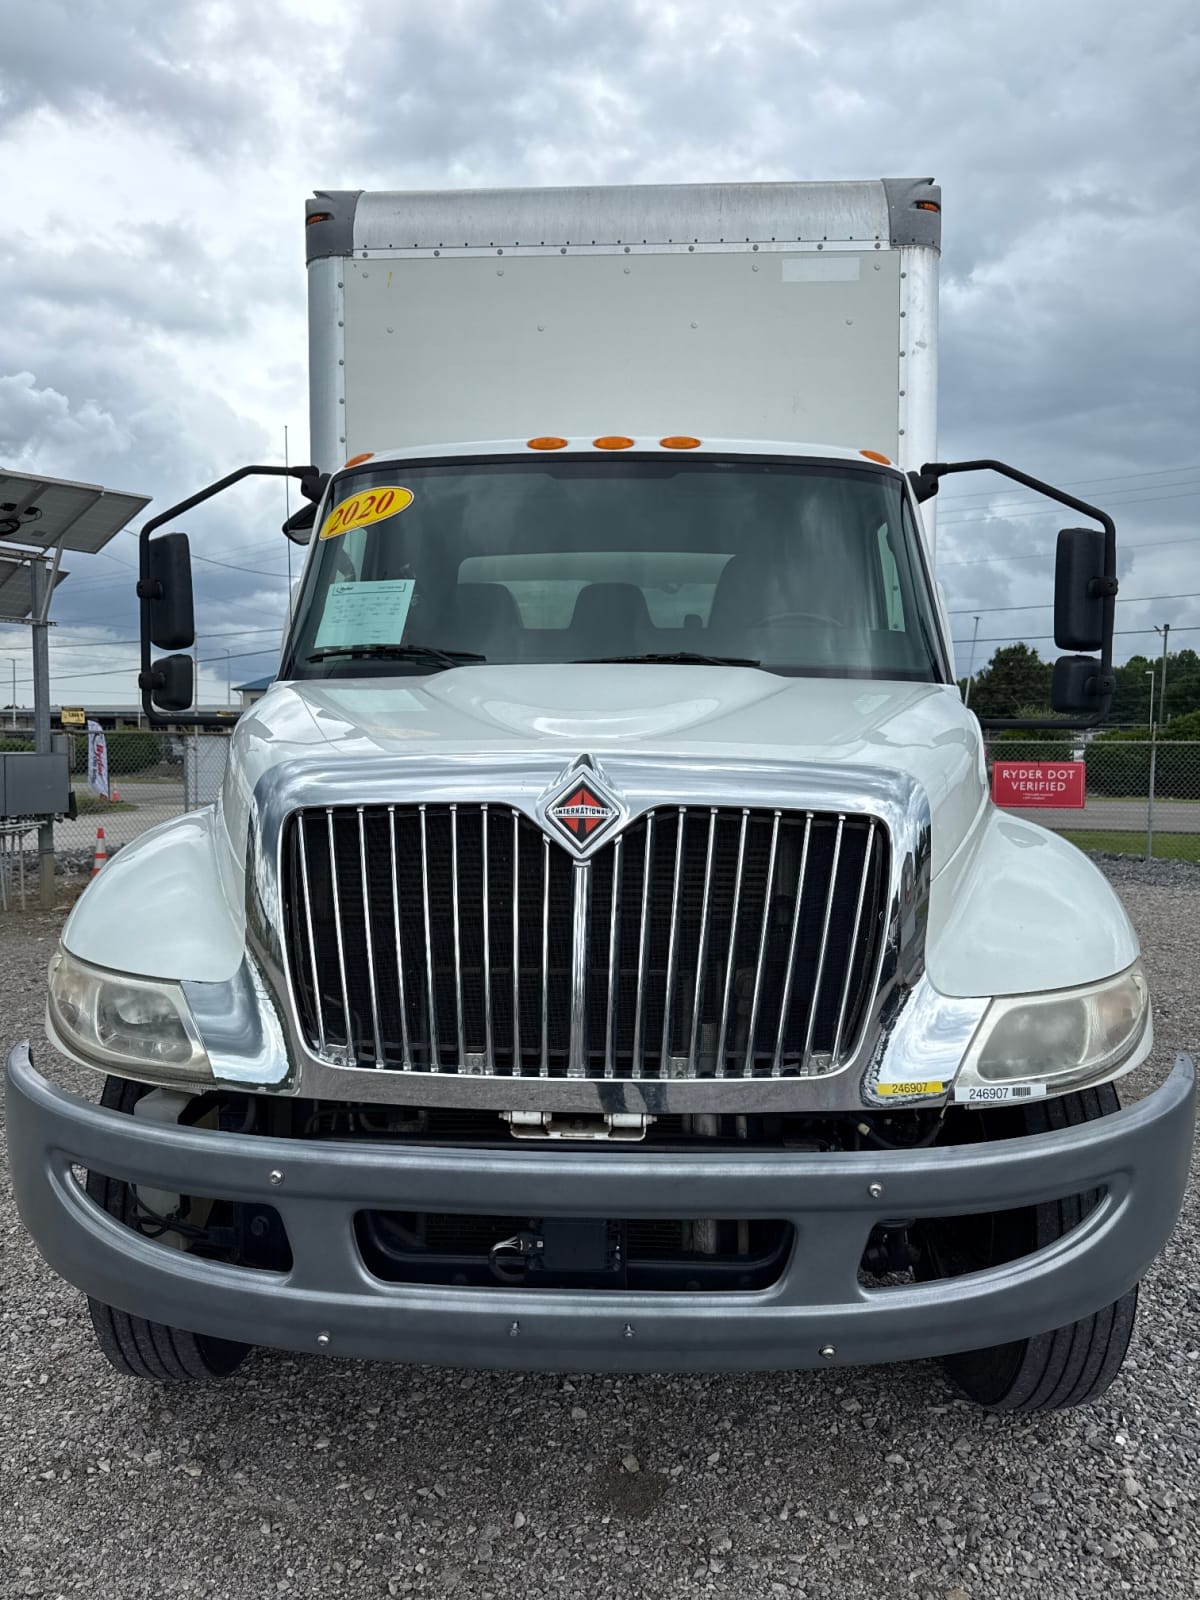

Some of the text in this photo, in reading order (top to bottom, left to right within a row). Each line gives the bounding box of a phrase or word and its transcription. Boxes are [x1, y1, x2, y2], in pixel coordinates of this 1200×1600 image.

[327, 490, 395, 535] 2020
[1002, 769, 1075, 780] RYDER DOT
[1011, 781, 1066, 792] VERIFIED
[555, 807, 609, 815] INTERNATIONAL
[892, 1082, 928, 1094] 246907
[969, 1087, 1009, 1100] 246907
